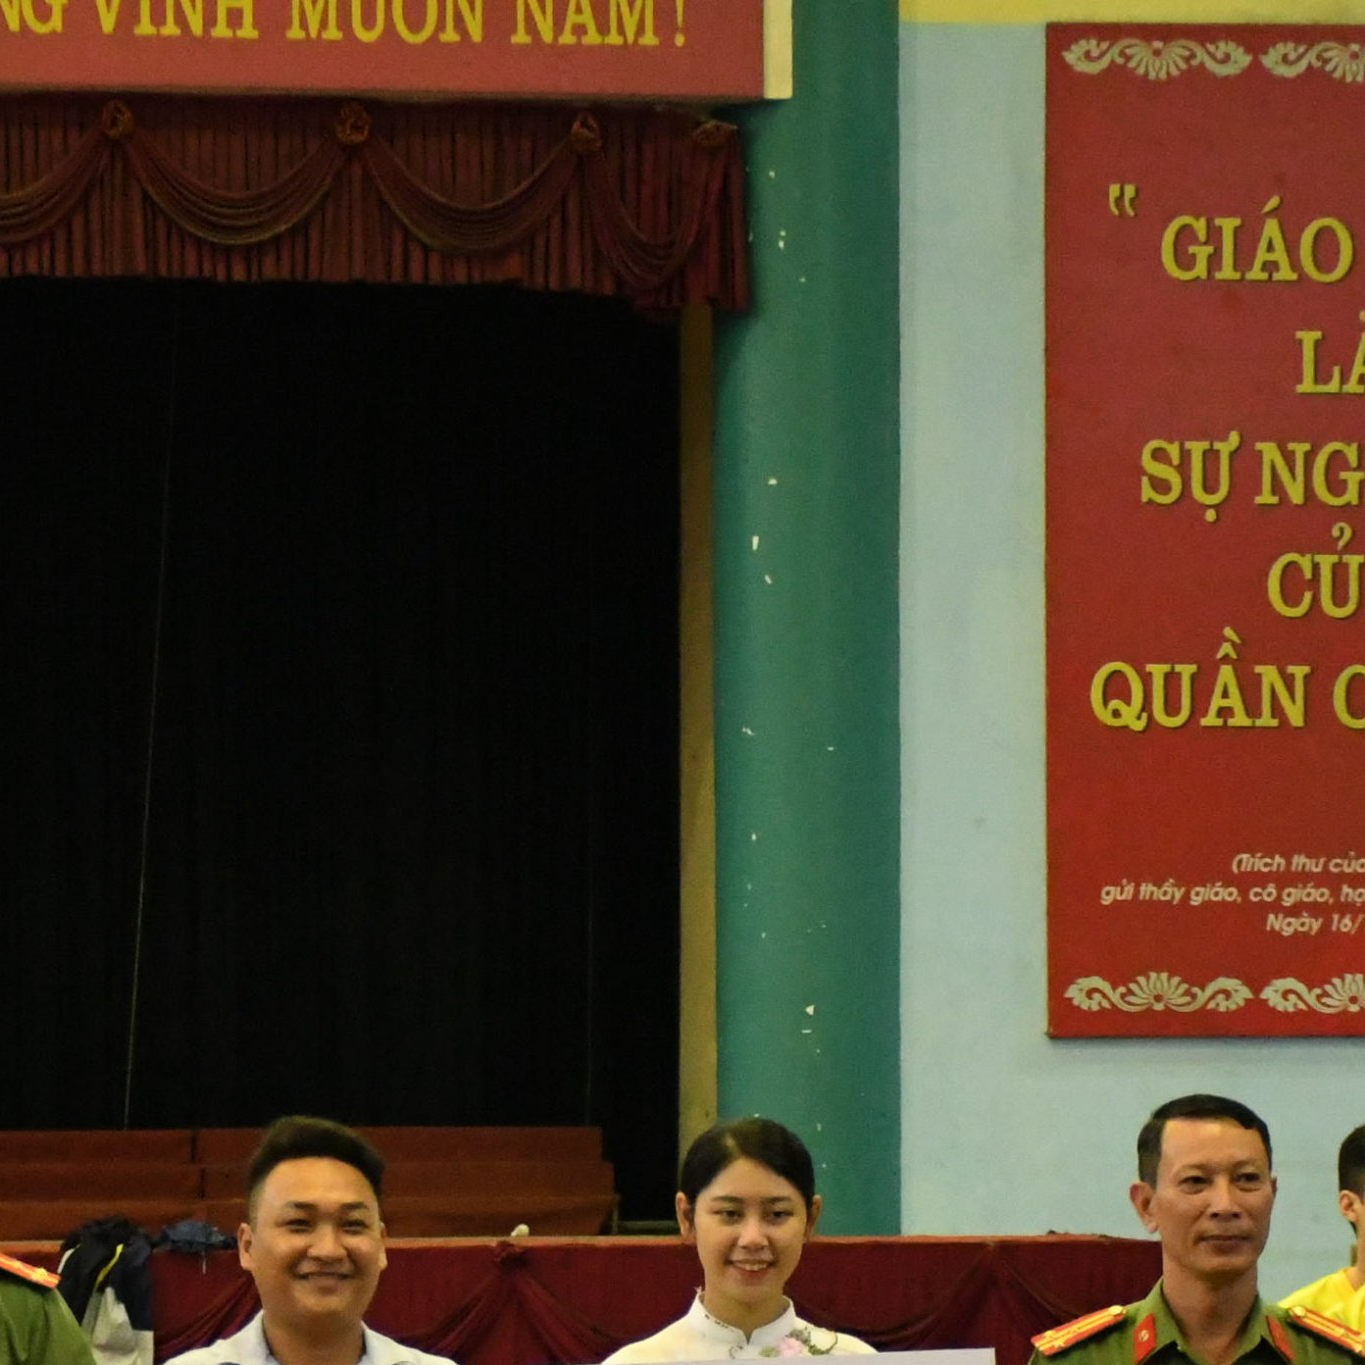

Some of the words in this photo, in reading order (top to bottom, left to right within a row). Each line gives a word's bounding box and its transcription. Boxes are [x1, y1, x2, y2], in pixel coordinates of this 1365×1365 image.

[1140, 430, 1241, 523] SỰ
[1090, 626, 1311, 732] QUẦN
[1232, 853, 1285, 874] (Trích
[1291, 853, 1326, 873] thư
[1139, 878, 1185, 904] thầy
[1189, 882, 1242, 906] giáo,
[1249, 883, 1277, 902] cô
[1282, 881, 1333, 906] giáo,
[1266, 911, 1323, 936] Ngày
